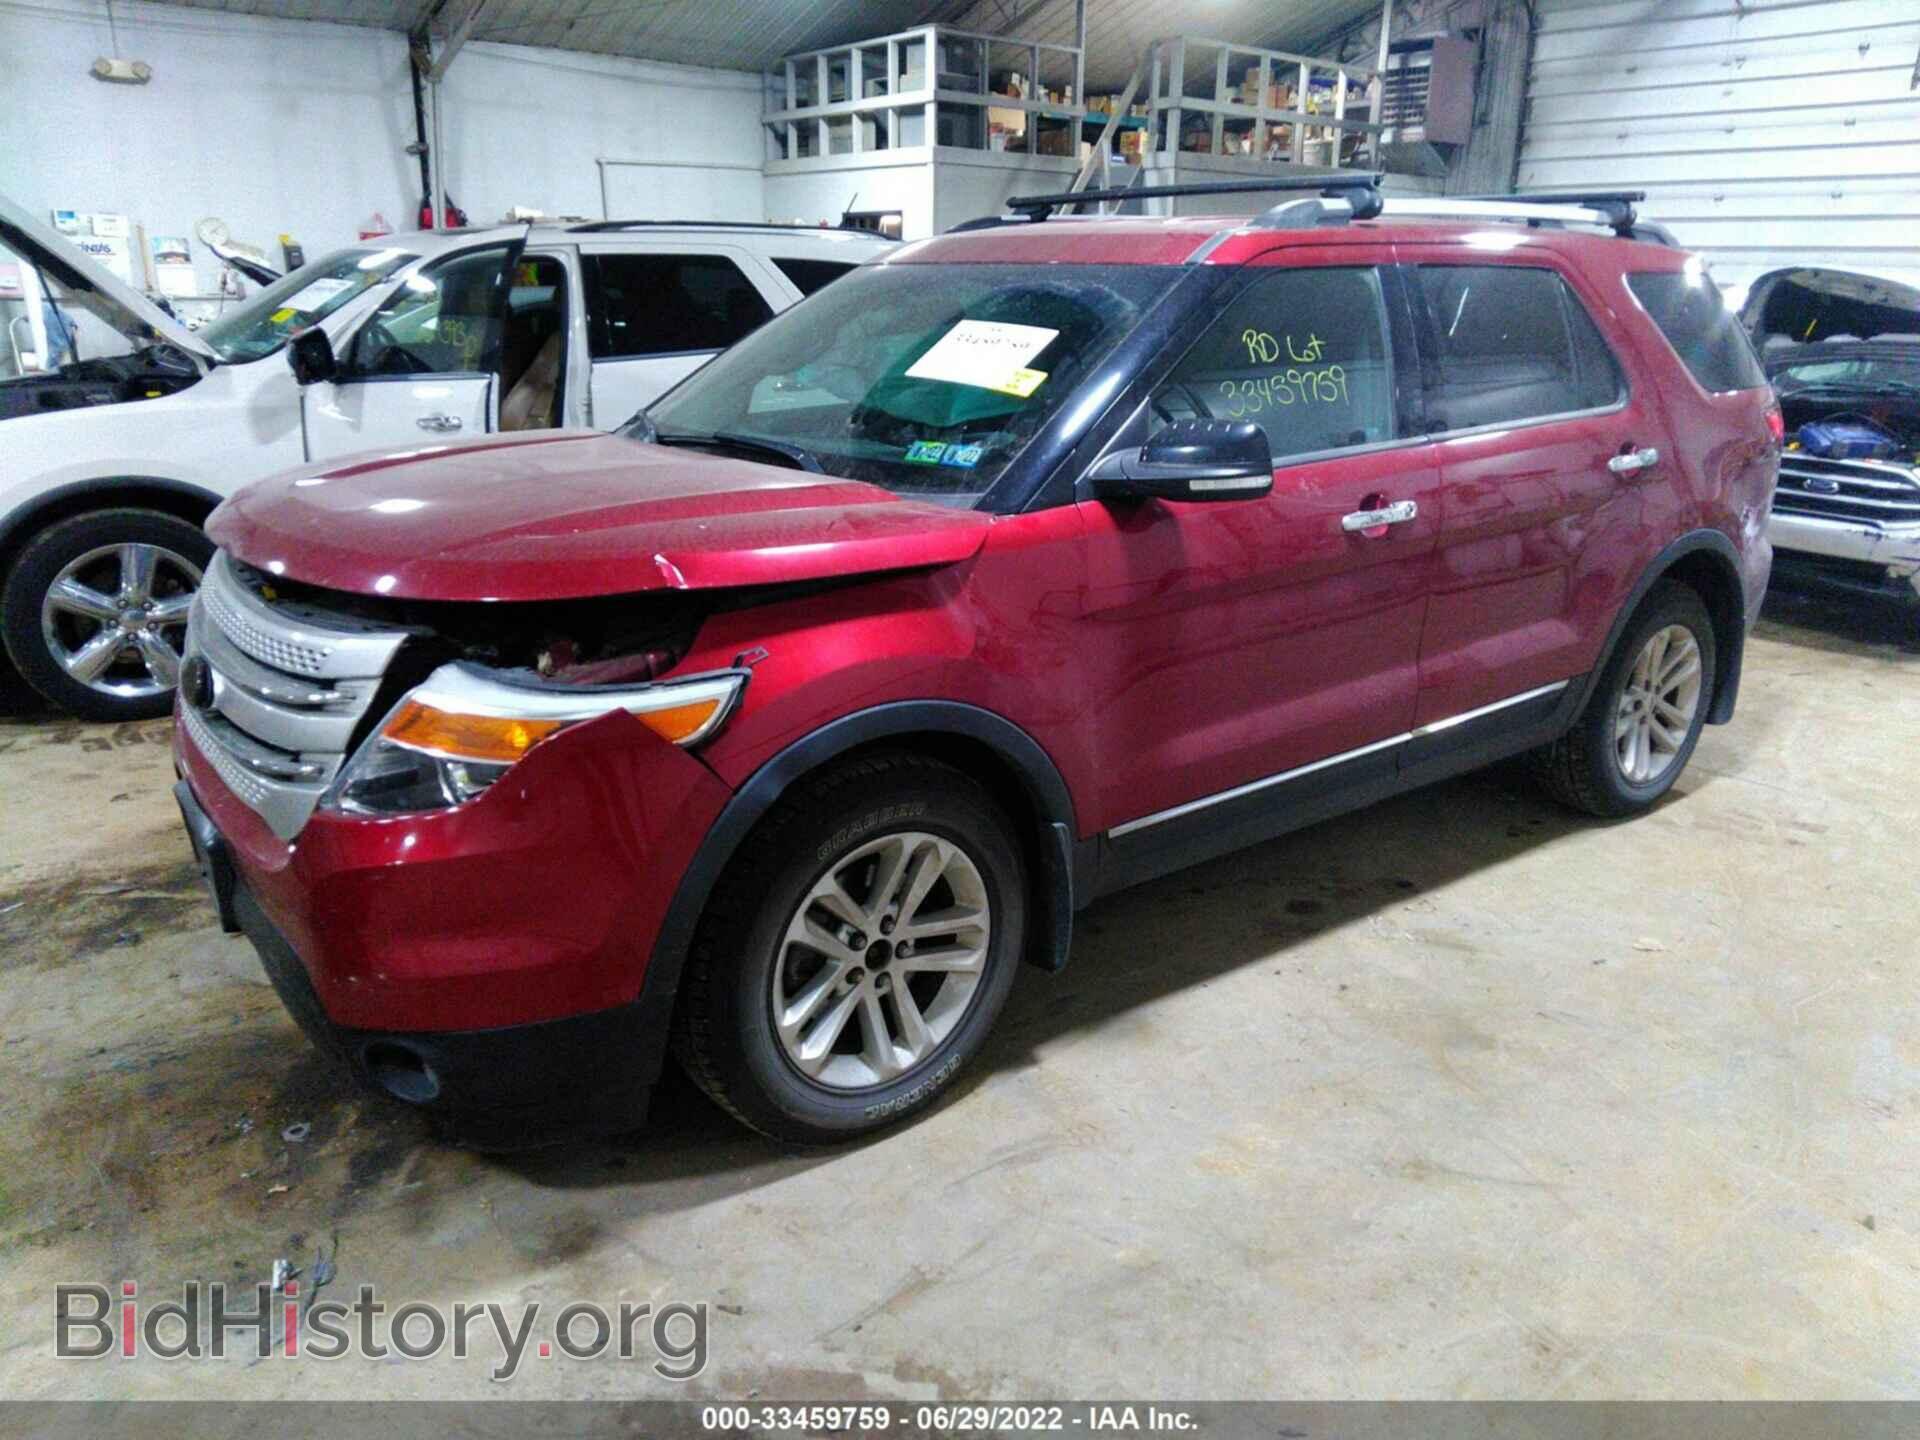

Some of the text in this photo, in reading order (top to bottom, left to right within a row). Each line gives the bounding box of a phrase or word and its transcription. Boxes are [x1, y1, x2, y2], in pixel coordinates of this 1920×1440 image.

[1241, 328, 1326, 364] RD Lot
[1219, 364, 1350, 418] 33459759
